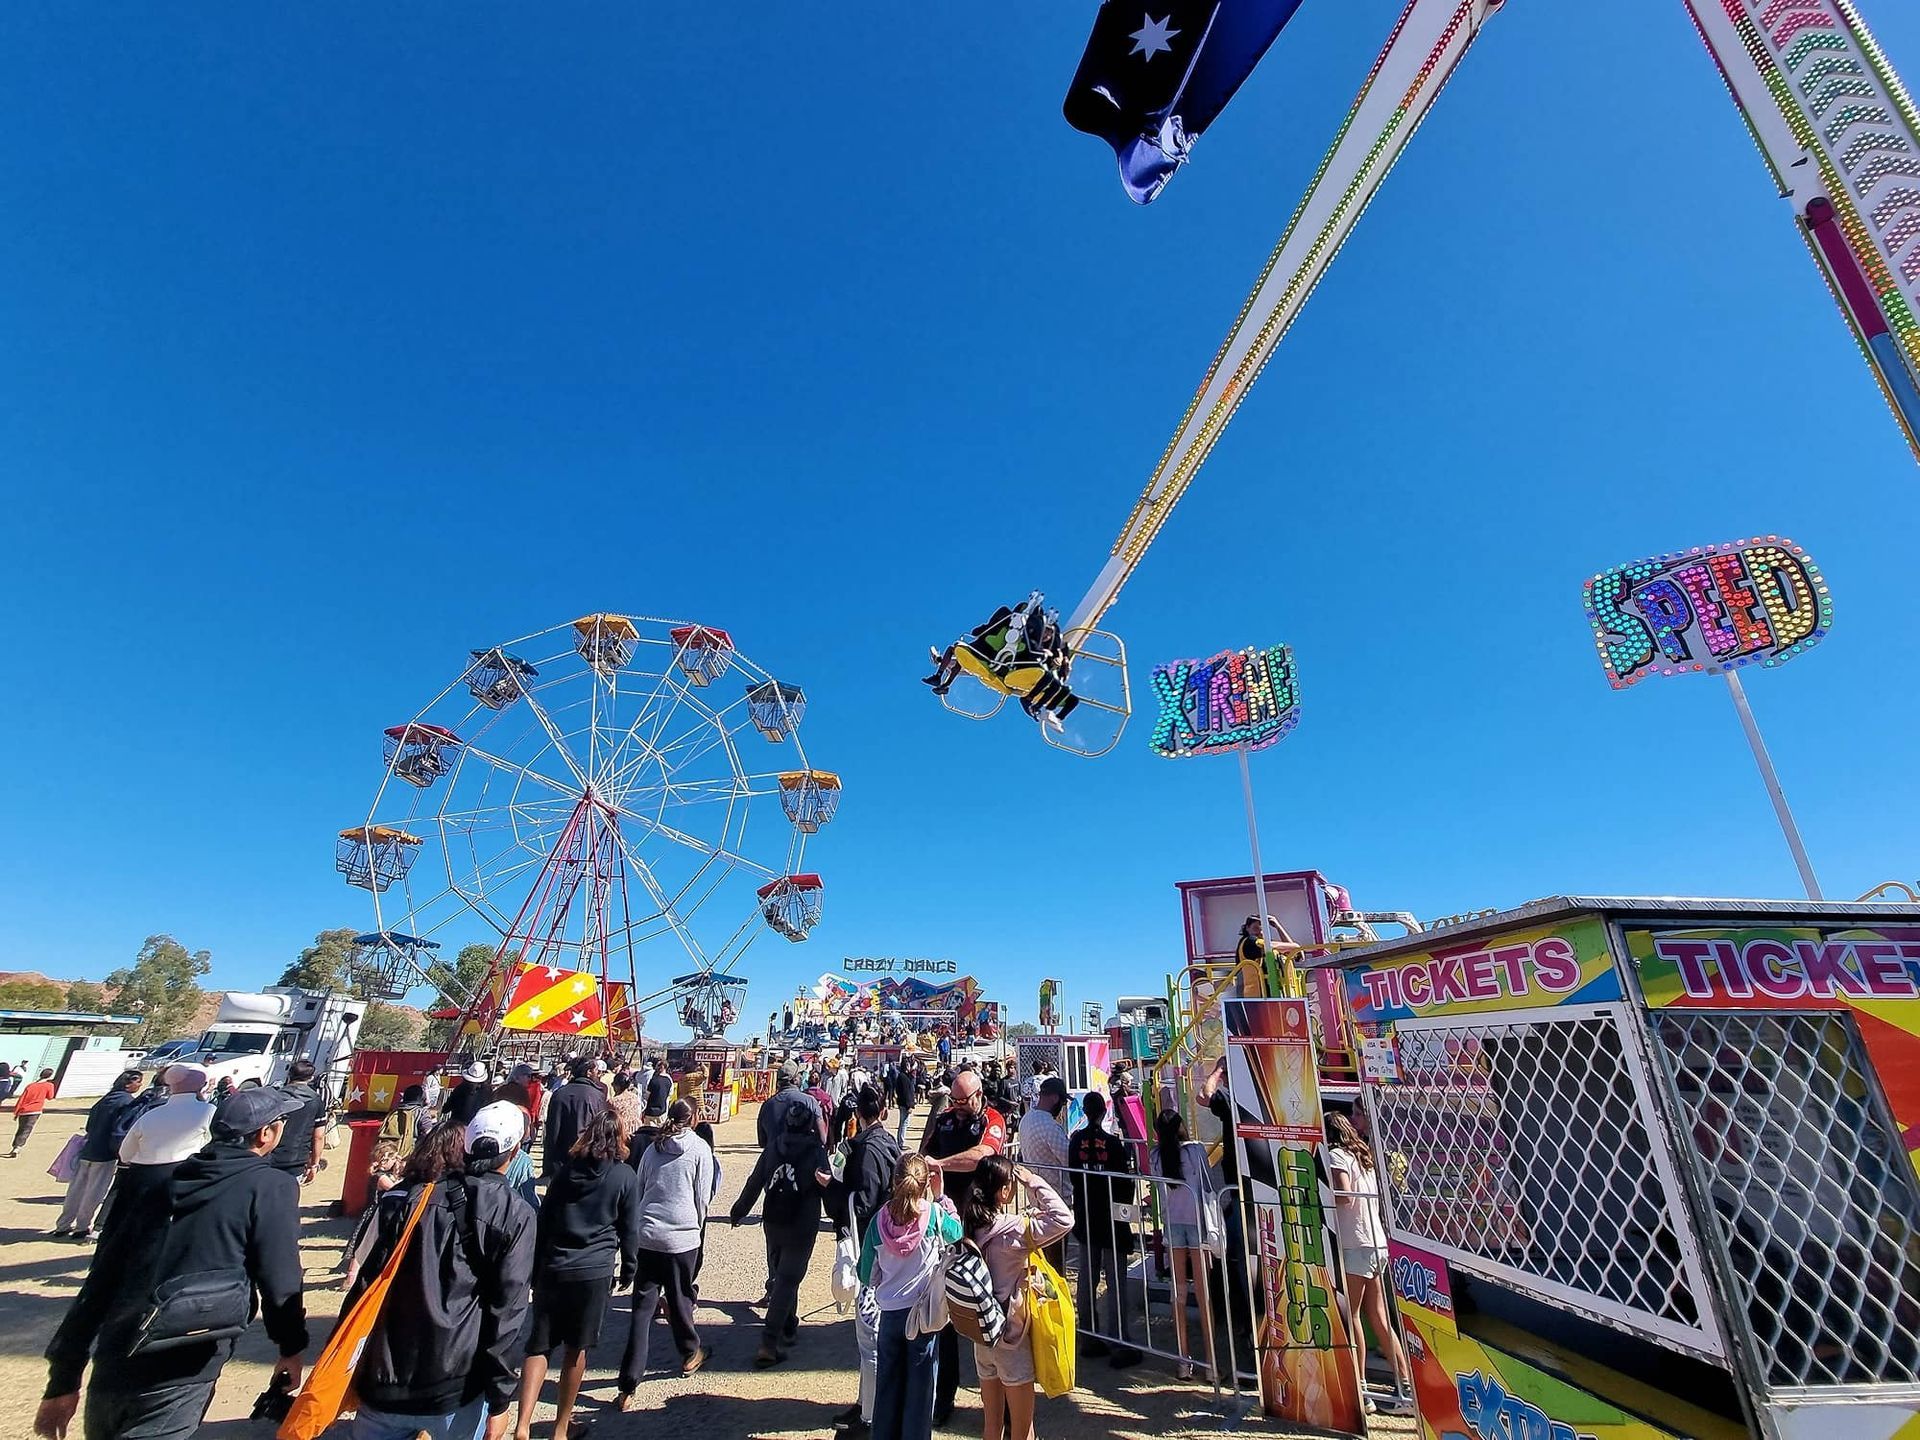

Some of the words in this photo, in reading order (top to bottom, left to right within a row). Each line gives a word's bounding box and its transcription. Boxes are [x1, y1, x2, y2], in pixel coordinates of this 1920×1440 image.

[1592, 546, 1820, 680] SPEED
[843, 957, 895, 972] CRAZY
[904, 958, 957, 974] DANCE
[1362, 937, 1581, 1011] TICKETS
[1278, 1146, 1331, 1351] SPEED
[1393, 1255, 1427, 1304] $20
[1456, 1368, 1598, 1440] EXTR
